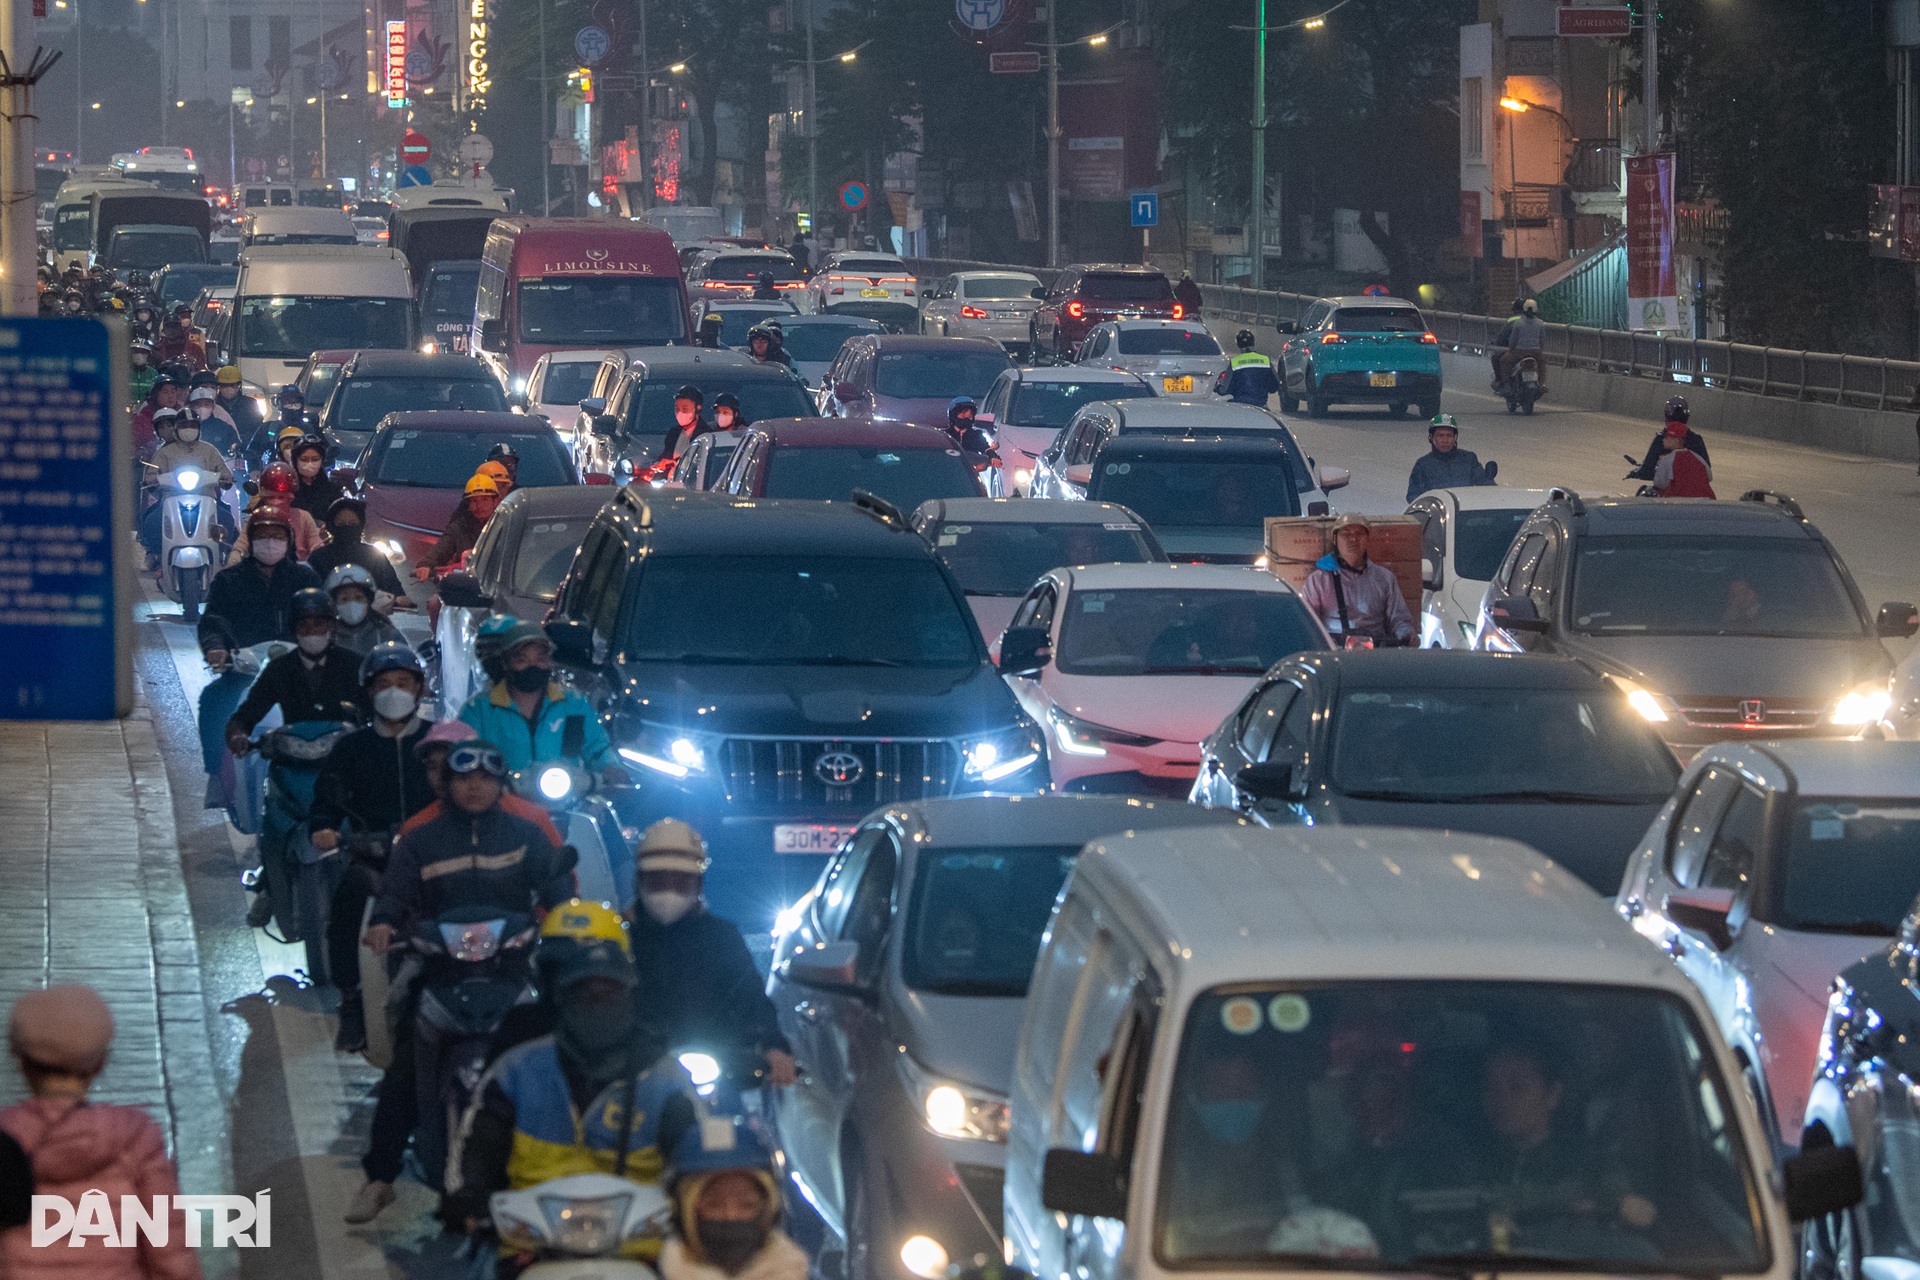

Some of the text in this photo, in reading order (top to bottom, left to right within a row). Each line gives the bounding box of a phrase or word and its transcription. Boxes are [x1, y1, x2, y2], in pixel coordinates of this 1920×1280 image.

[1574, 19, 1628, 27] AGRIBANK
[544, 261, 652, 273] LIMOUSINE
[436, 321, 463, 332] CÔNG
